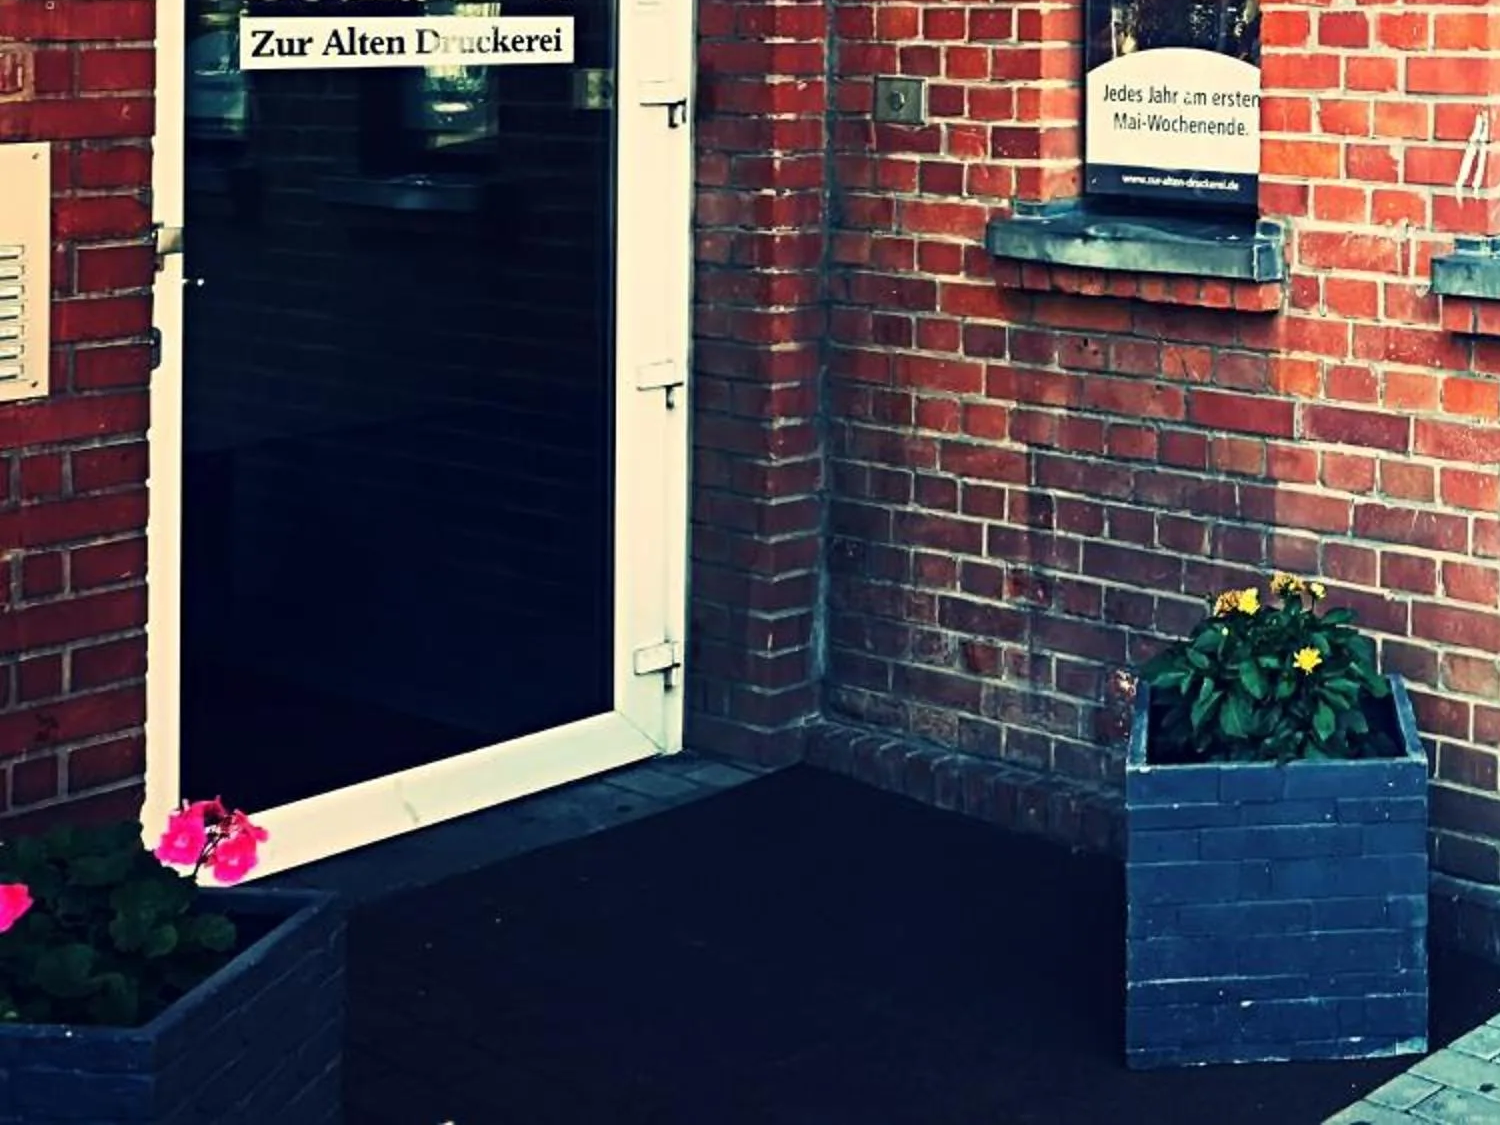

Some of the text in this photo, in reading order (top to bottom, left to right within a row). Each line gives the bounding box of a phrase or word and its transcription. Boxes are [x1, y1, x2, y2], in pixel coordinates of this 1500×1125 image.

[250, 27, 564, 58] Zur Alten Druckerei
[1104, 84, 1261, 108] Jedes Jahr am ersten
[1113, 111, 1250, 137] Mai-Wochenende.
